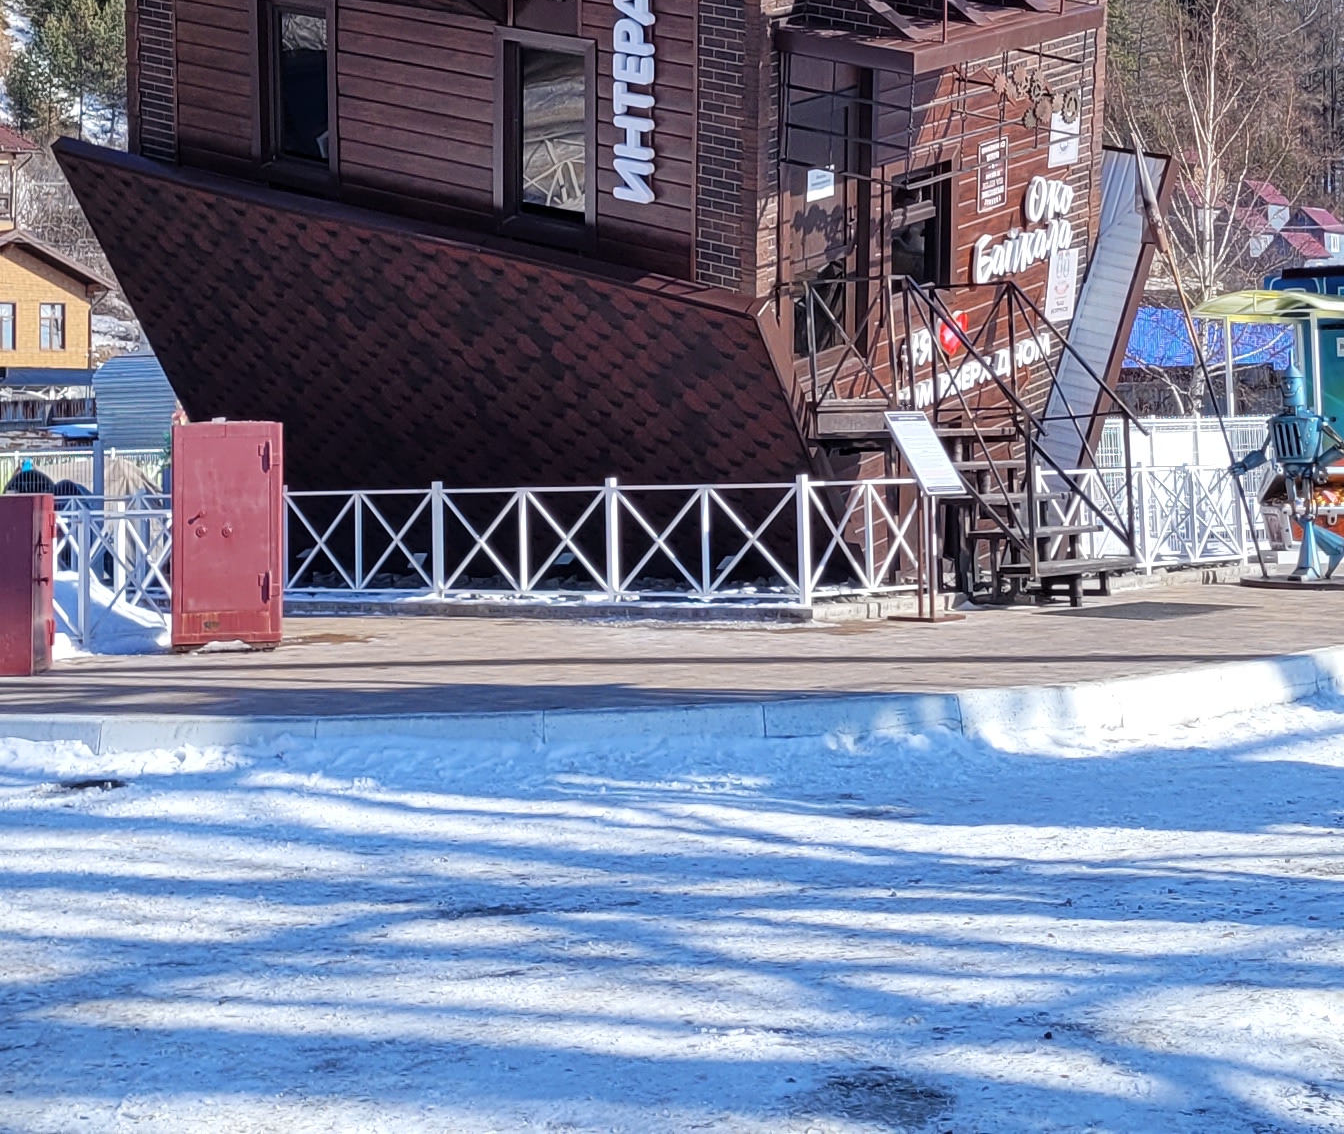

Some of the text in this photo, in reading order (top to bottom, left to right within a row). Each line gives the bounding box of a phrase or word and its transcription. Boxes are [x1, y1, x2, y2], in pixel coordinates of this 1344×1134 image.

[1025, 176, 1074, 222] Око
[973, 219, 1073, 284] Байкала
[995, 332, 1051, 378] ДНОМ
